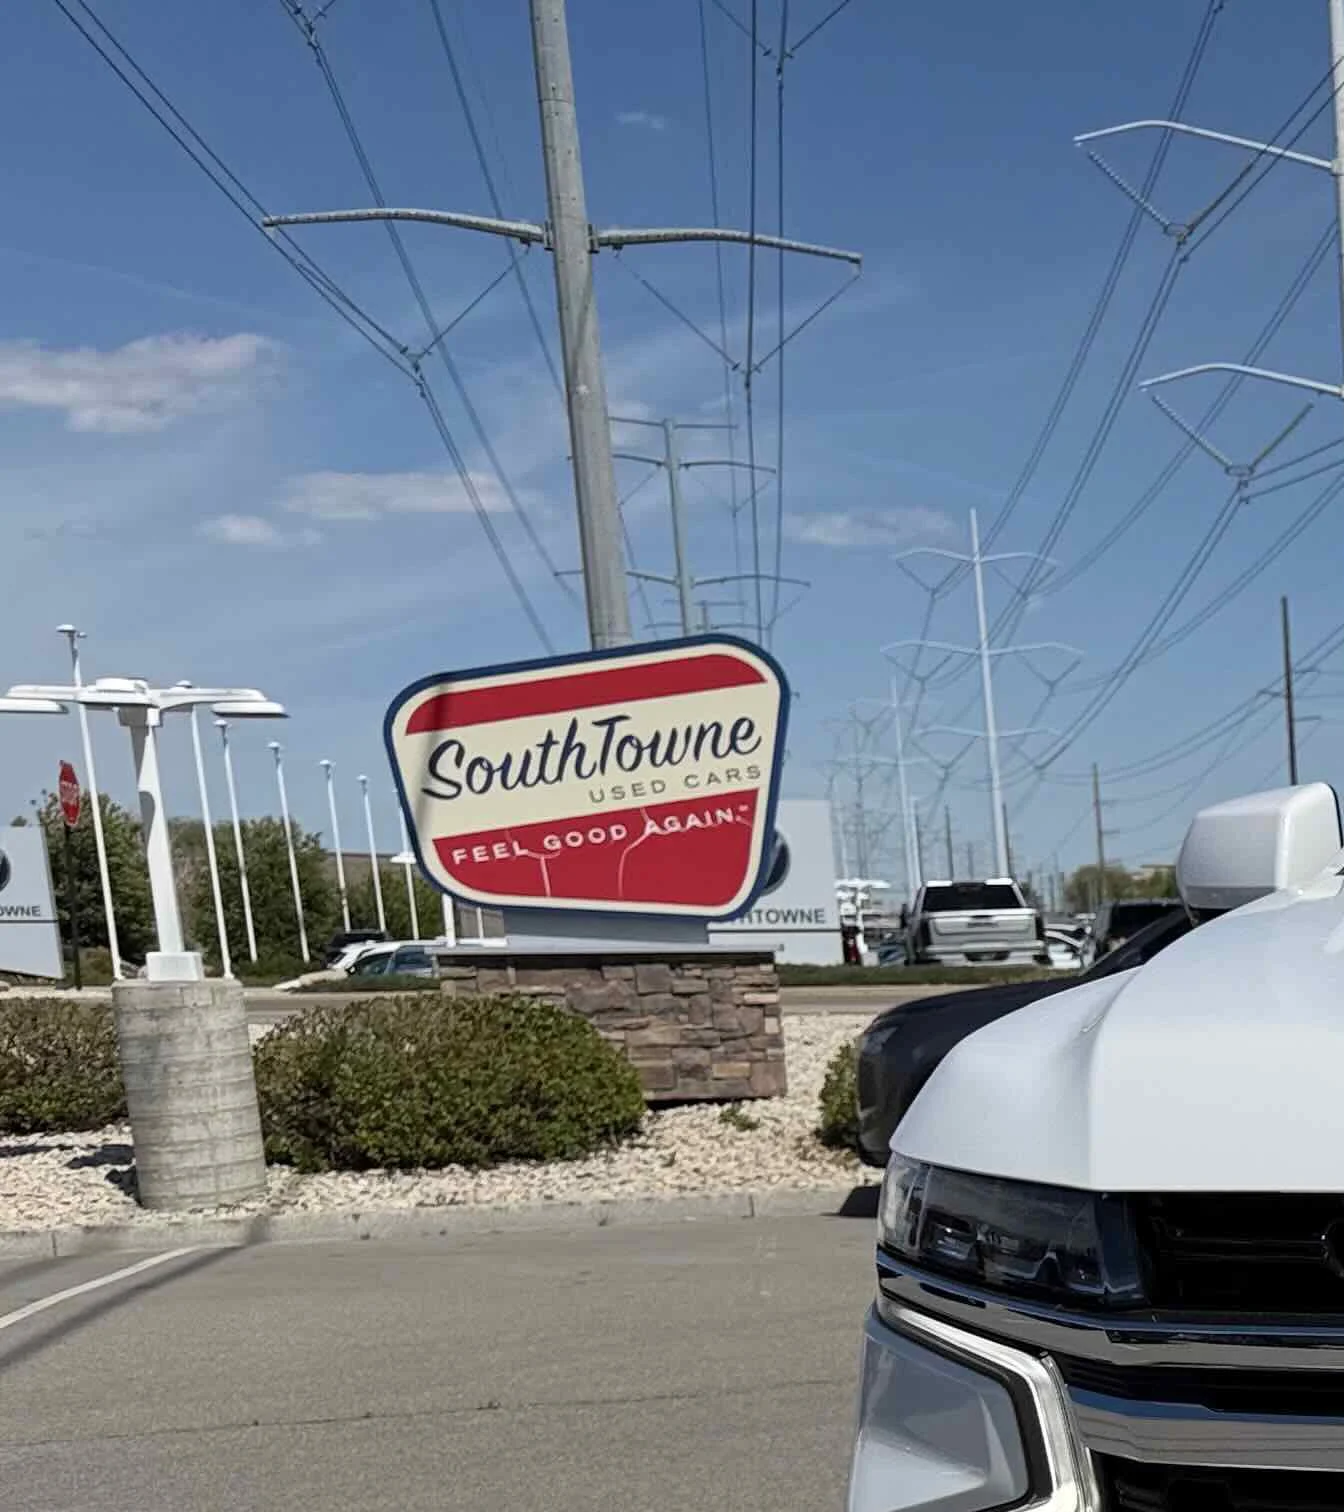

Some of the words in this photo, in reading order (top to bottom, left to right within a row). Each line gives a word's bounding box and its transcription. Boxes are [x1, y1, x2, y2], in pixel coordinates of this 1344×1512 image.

[421, 714, 762, 800] SouthTowne
[589, 778, 667, 803] USED
[683, 765, 762, 789] CARS
[451, 839, 530, 865] FEEL
[543, 823, 628, 851] GOOD
